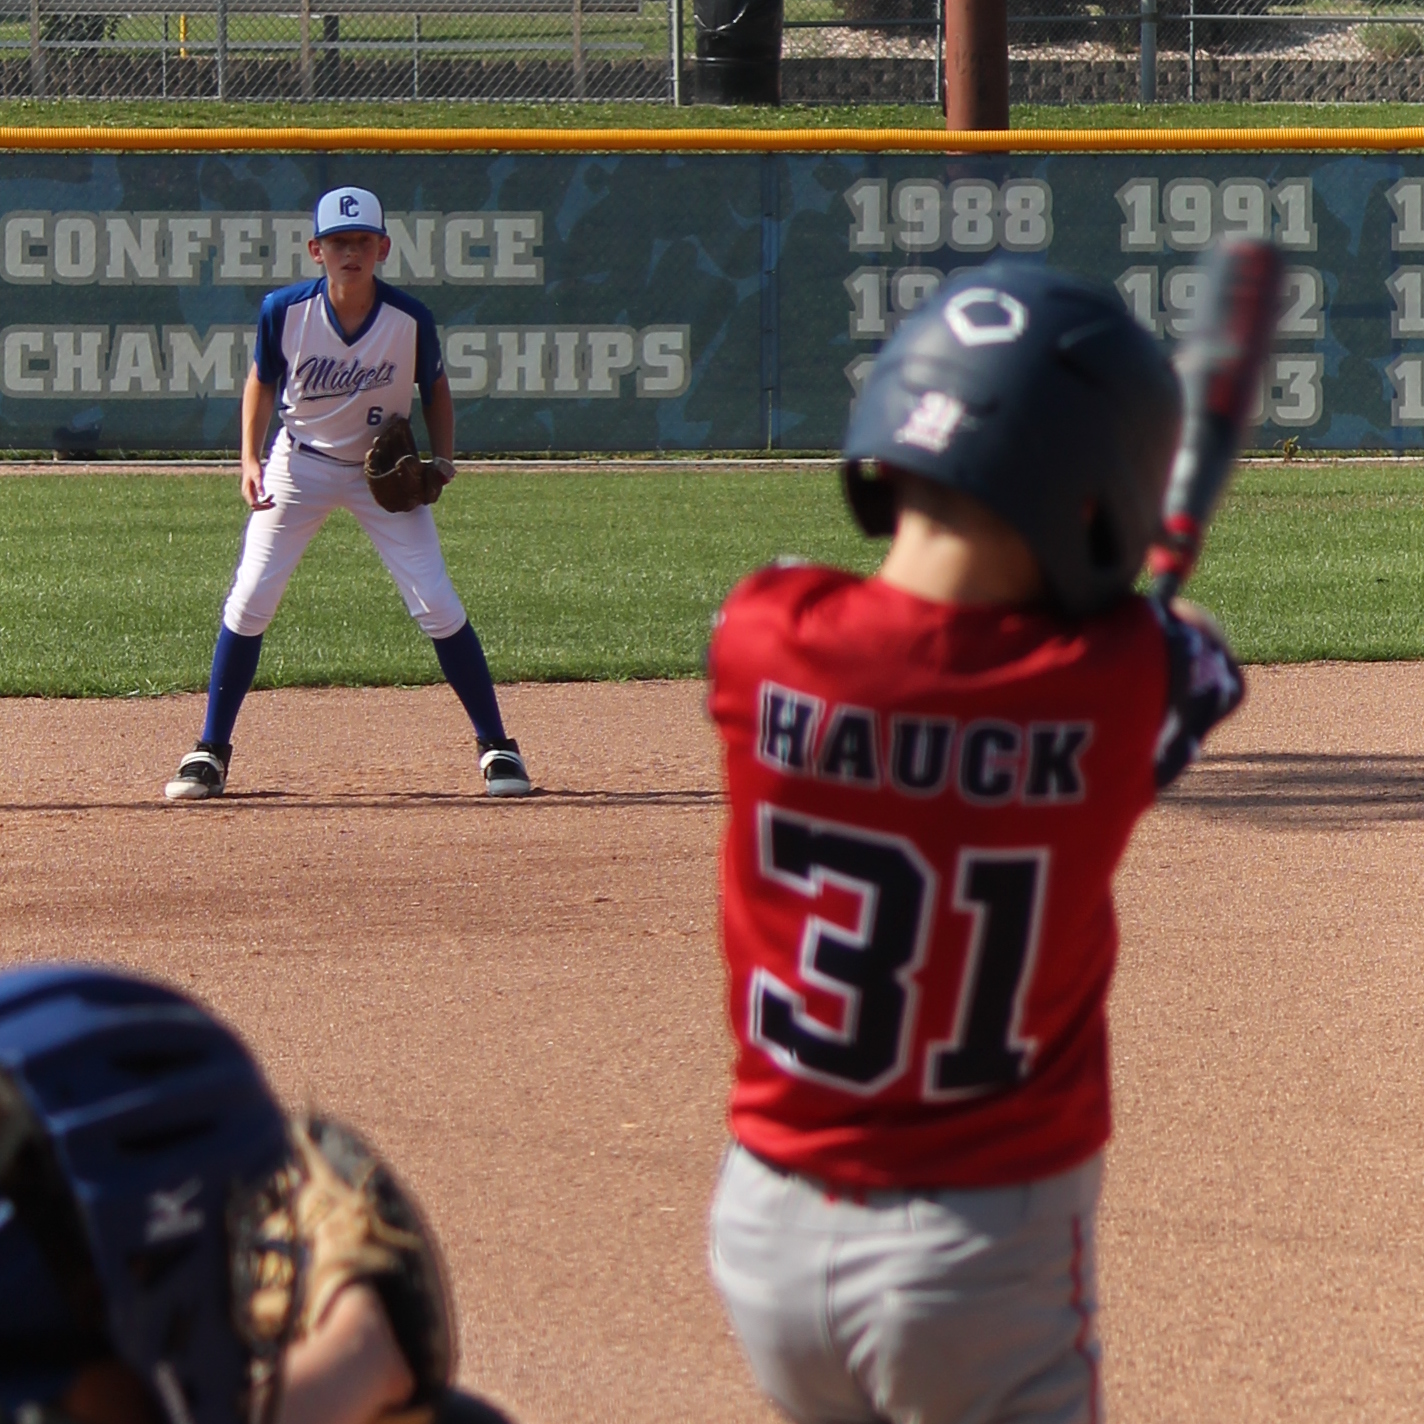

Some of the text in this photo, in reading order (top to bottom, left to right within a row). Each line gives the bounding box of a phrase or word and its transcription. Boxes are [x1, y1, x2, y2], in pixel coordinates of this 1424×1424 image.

[339, 195, 360, 218] PC
[844, 178, 1053, 251] 1988
[1115, 177, 1317, 250] 1991
[0, 210, 543, 285] CONFERNCE
[1114, 265, 1325, 339] 192
[0, 324, 691, 399] CHAMSHIPS
[296, 354, 395, 401] Midgets
[366, 406, 383, 425] 6
[757, 679, 1094, 806] HAUCK
[749, 803, 1050, 1103] 31
